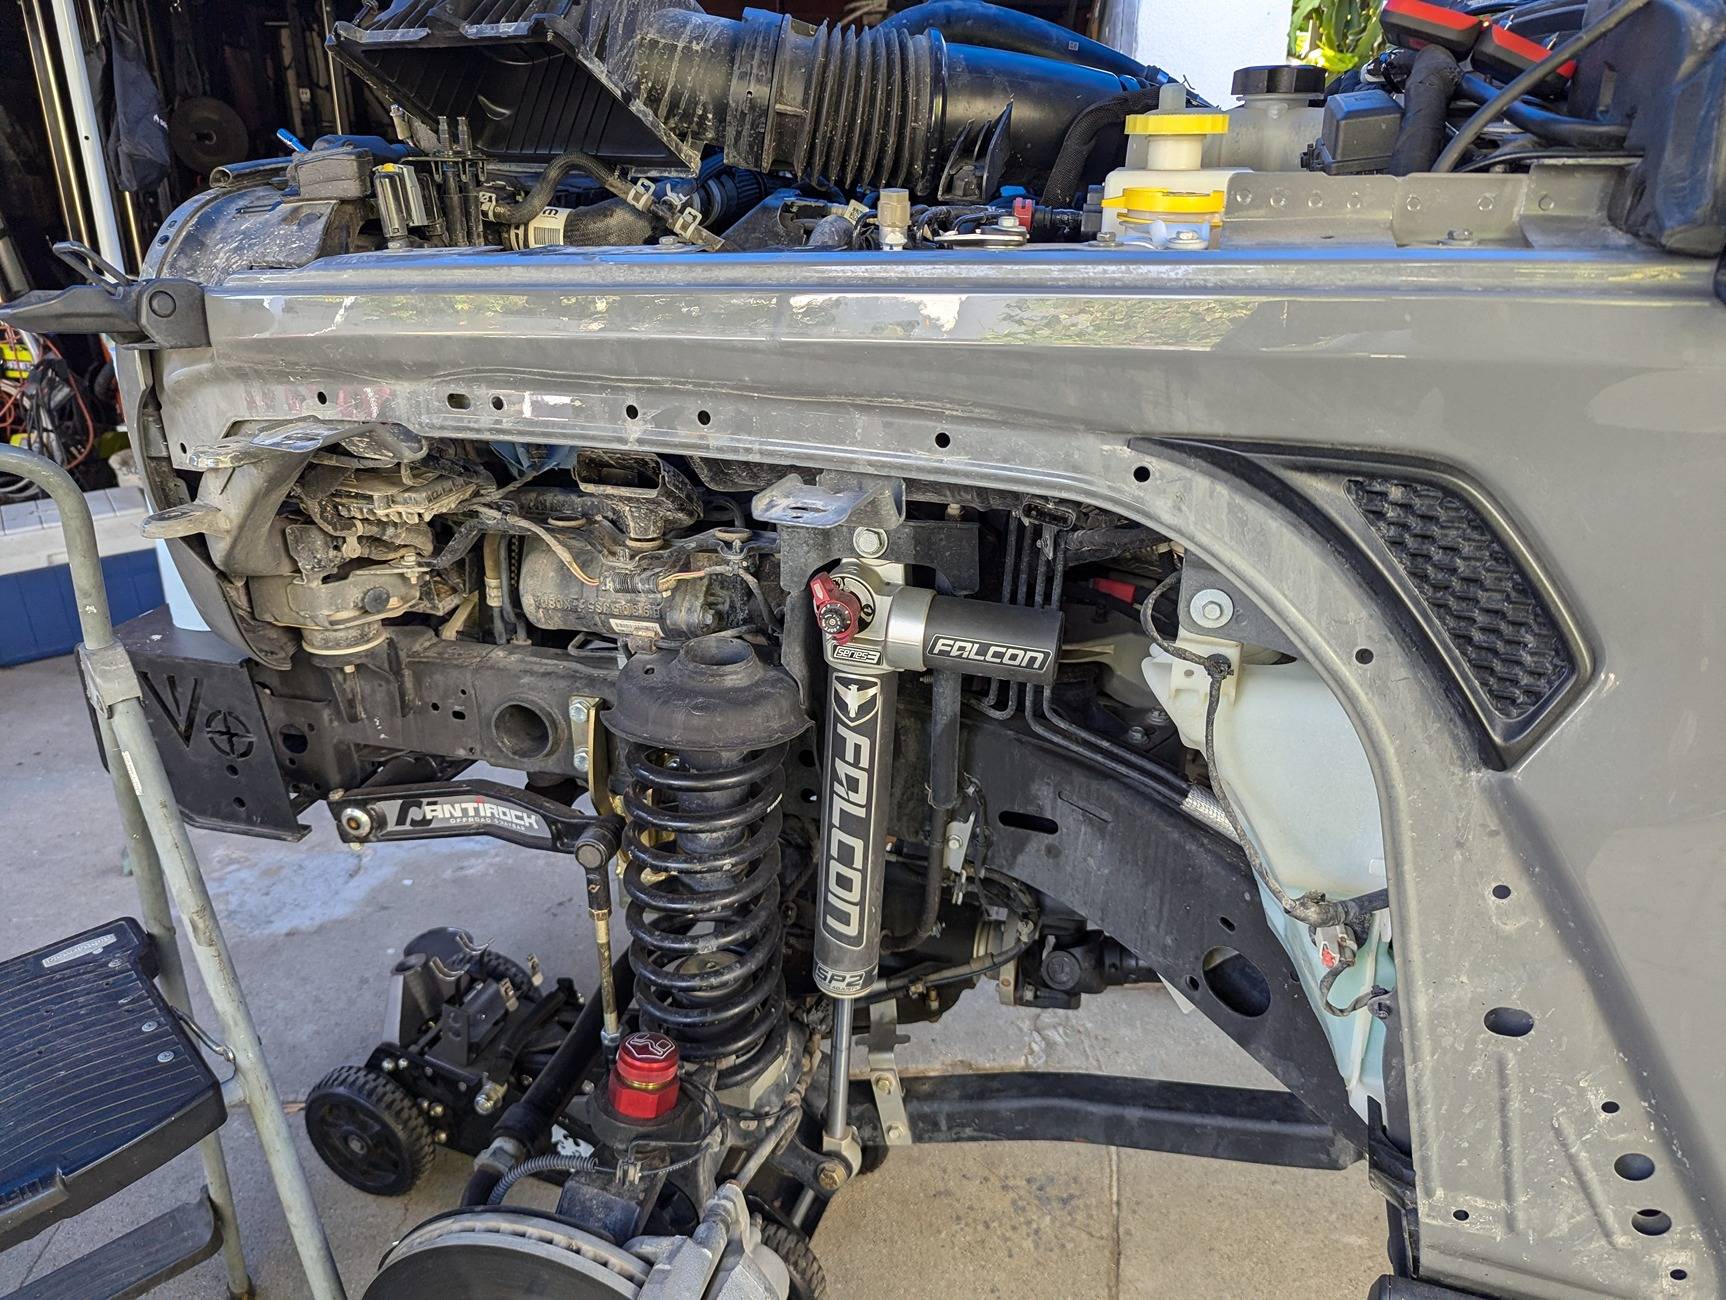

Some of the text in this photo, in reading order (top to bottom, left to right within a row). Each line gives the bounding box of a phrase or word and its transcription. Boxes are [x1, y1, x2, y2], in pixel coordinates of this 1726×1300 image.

[933, 638, 1045, 669] FALCON
[424, 802, 539, 830] ANTIROCK
[826, 723, 872, 937] FALCON
